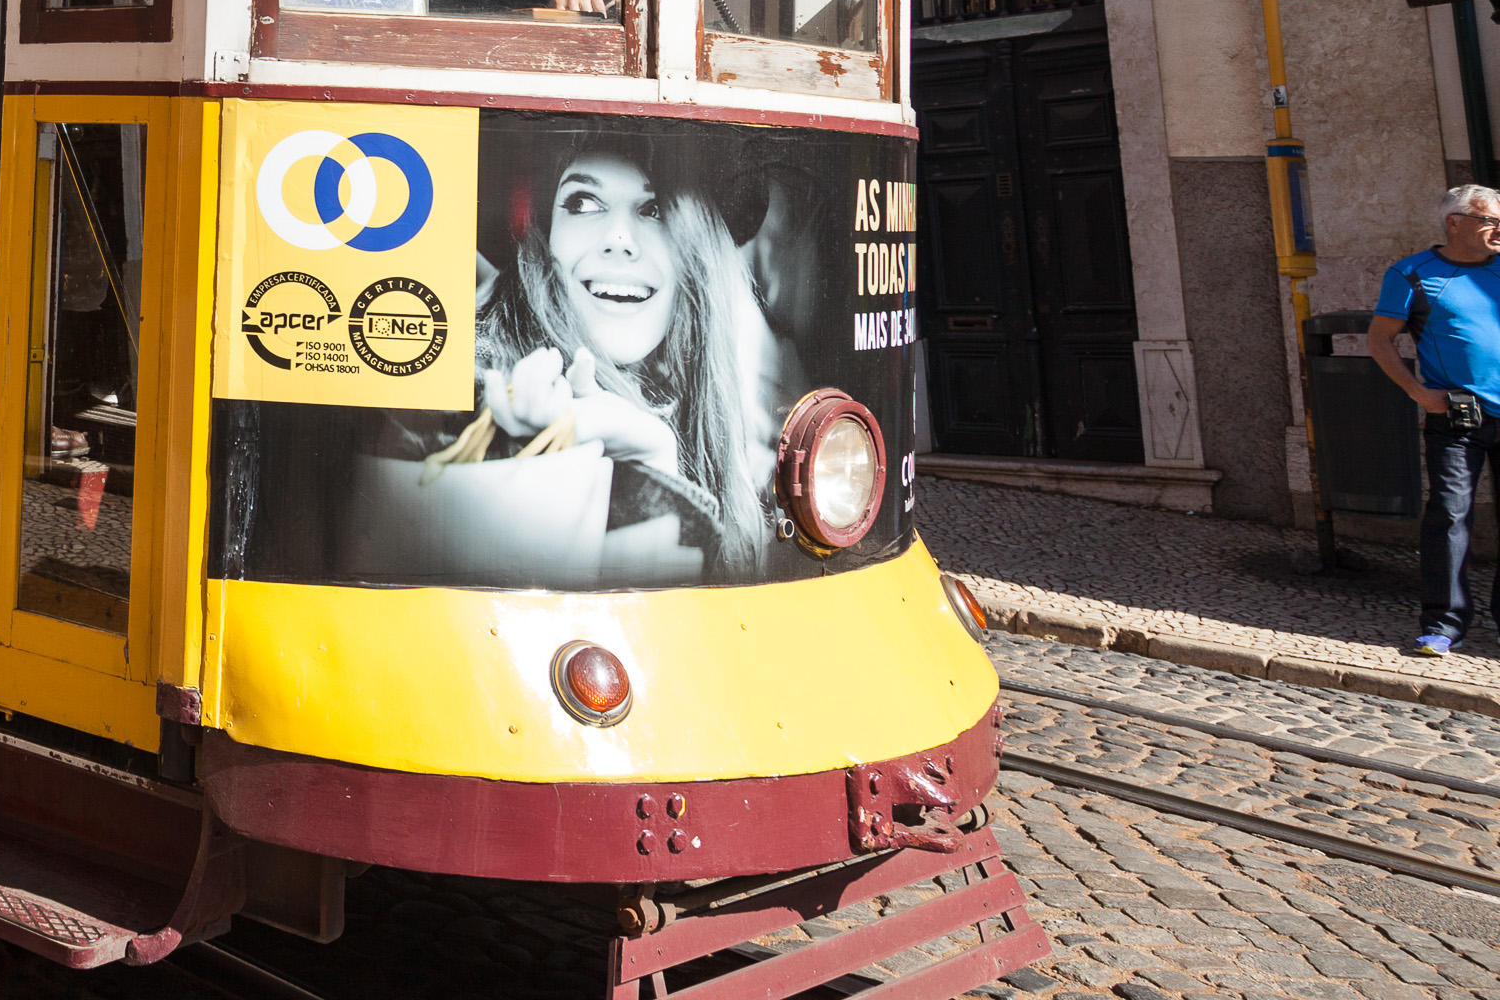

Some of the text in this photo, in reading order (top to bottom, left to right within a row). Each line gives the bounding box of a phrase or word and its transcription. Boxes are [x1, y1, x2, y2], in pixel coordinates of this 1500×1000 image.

[854, 178, 880, 232] AS
[854, 242, 906, 296] TODAS
[249, 272, 337, 309] EMPRESA CERTIFICADA
[357, 280, 440, 312] CERTIFIED
[260, 311, 325, 335] apcer
[368, 317, 428, 337] IQNet
[854, 311, 888, 351] MAIS
[890, 309, 903, 347] DE
[305, 341, 346, 352] ISO 9001
[305, 351, 349, 363] ISO 14001
[352, 331, 444, 374] MANAGEMENT SYSTEM
[304, 362, 360, 374] OHSAS 18001
